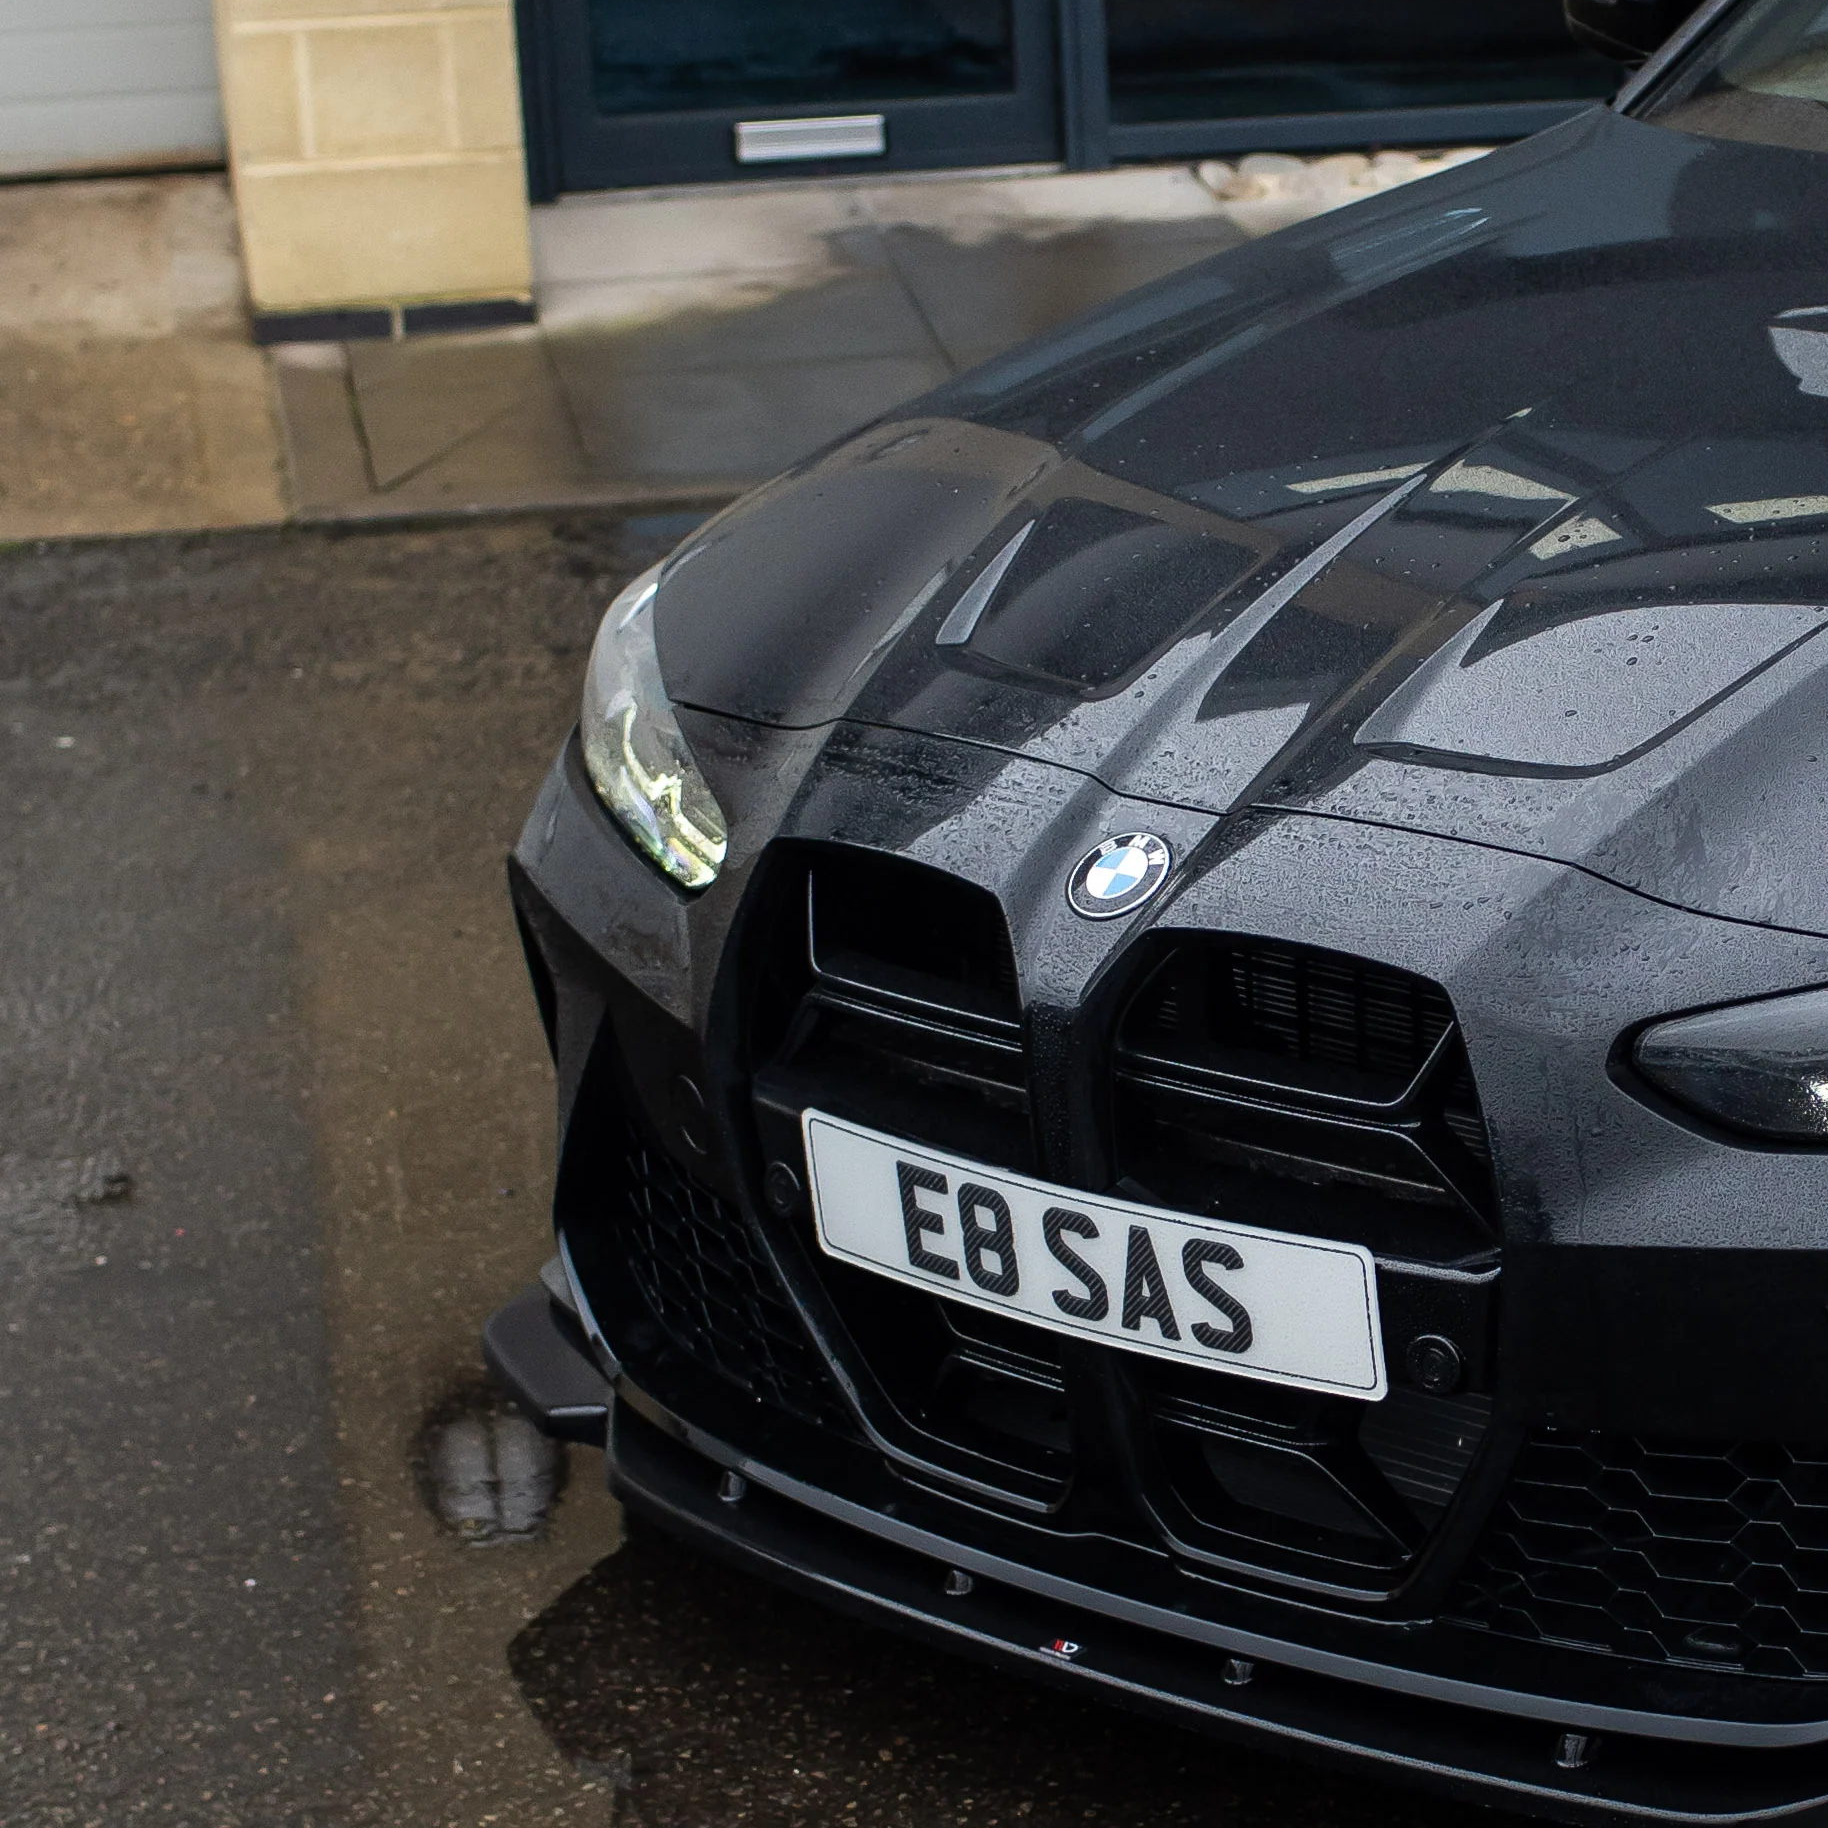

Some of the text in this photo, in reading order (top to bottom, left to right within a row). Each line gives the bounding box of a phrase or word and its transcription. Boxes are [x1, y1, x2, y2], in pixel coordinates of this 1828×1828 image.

[1099, 835, 1165, 866] BMW
[896, 1160, 1254, 1353] E8 SAS
